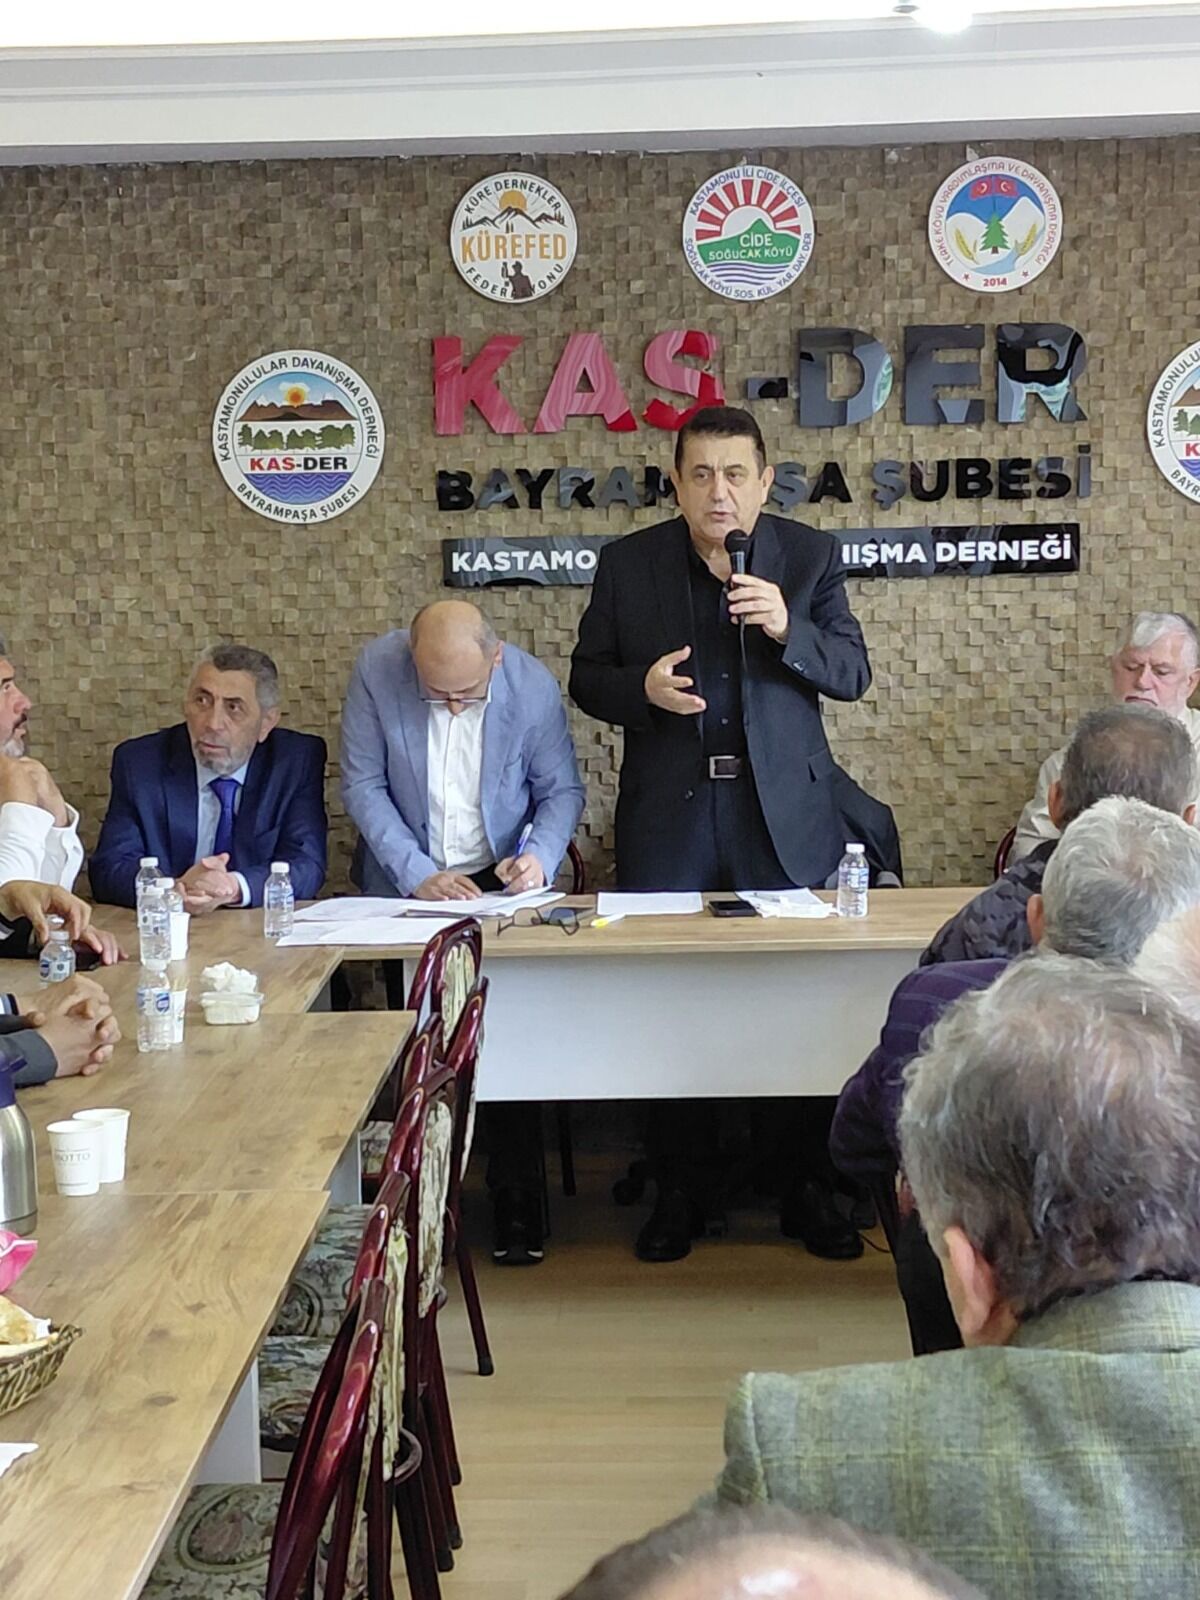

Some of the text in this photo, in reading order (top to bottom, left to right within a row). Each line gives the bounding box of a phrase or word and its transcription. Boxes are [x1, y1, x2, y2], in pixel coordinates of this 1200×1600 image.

[464, 178, 562, 214] KÜRE DERNEKLER
[689, 169, 740, 216] KASTAMONU
[461, 230, 567, 264] KÜREFED
[709, 245, 793, 260] SOĞUCAK KÖYÜ
[740, 232, 773, 248] CİDE
[465, 263, 564, 298] FEDERYONU
[983, 277, 1008, 287] 2014
[217, 357, 288, 462] KASTAMONULULAR
[292, 356, 361, 397] DAYANIŞMA
[1152, 347, 1200, 447] KASTAMONULU
[250, 457, 348, 471] KAS-DER
[871, 444, 1092, 510] ŞUBESİ
[237, 482, 360, 522] BAYRAMPAŞA ŞUBESİ
[451, 549, 598, 573] KASTAMO
[935, 533, 1072, 564] DERNEĞİ
